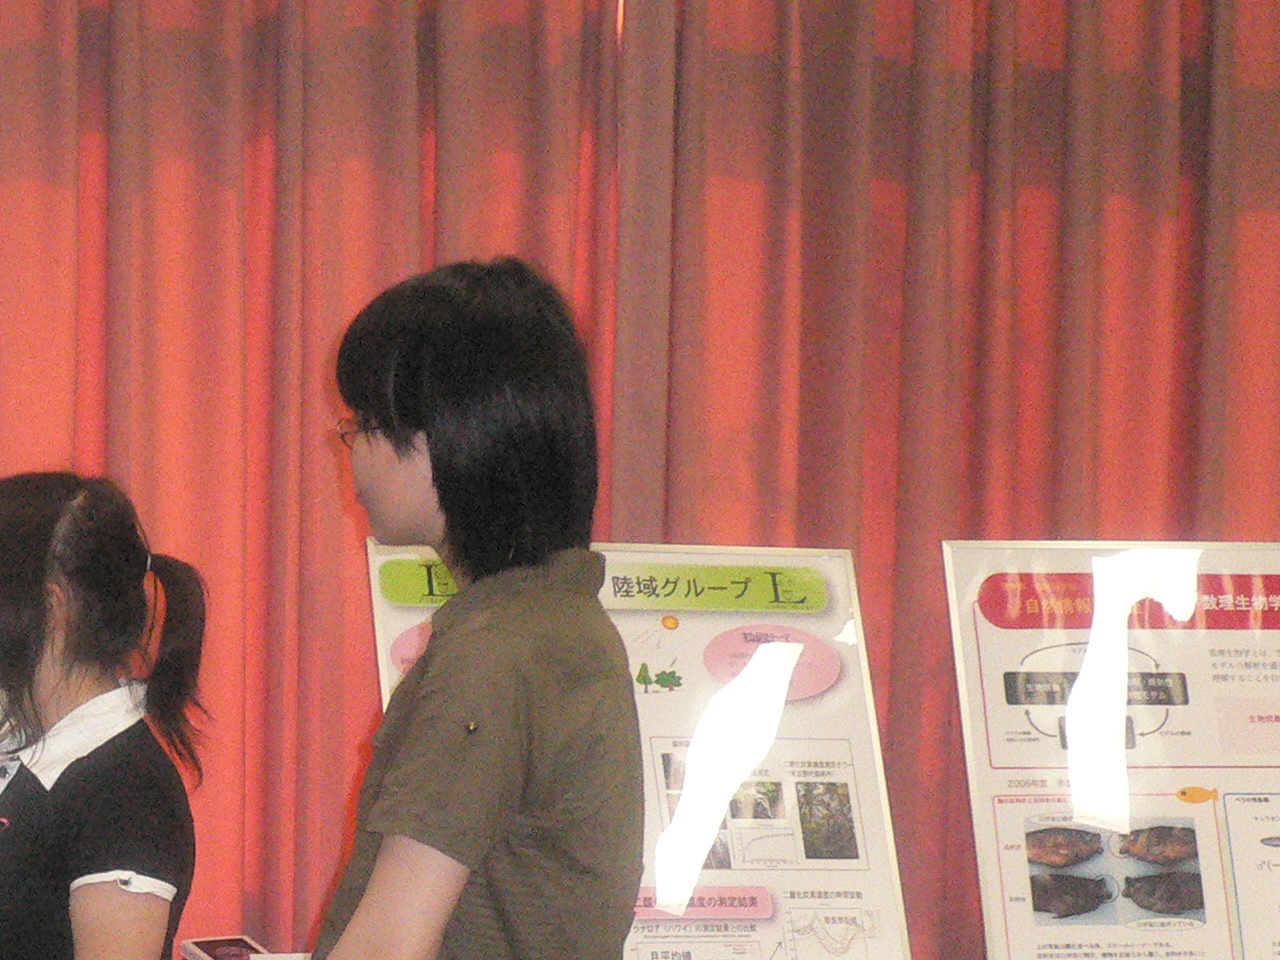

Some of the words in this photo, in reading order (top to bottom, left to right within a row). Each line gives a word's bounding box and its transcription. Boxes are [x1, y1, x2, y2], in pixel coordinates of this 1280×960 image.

[611, 574, 752, 599] 陸域グループ
[1201, 594, 1280, 611] 数理生物学
